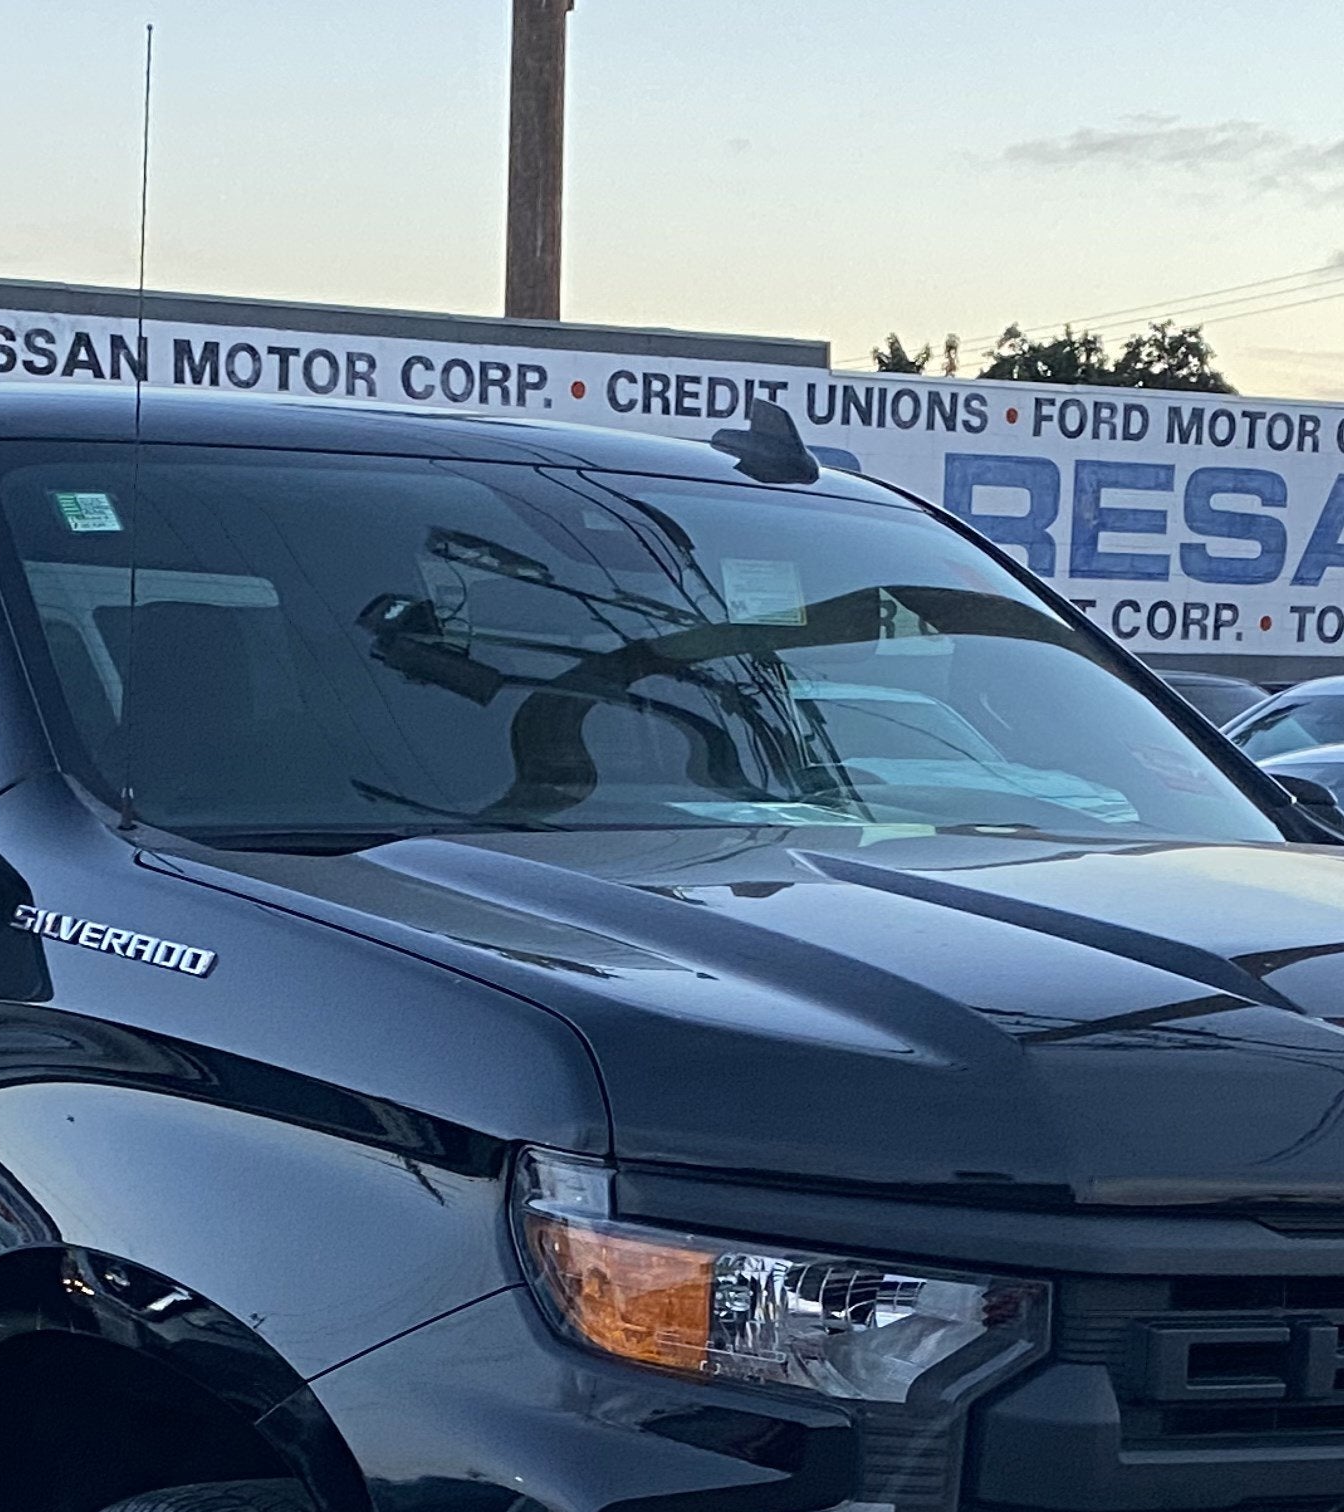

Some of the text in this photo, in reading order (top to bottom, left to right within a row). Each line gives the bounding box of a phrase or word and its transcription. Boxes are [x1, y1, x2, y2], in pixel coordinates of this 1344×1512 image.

[172, 338, 377, 398] MOTOR
[401, 355, 552, 409] CORP.
[607, 370, 788, 420] CREDIT
[807, 382, 988, 434] UNIONS
[1032, 397, 1149, 442] FORD
[1167, 405, 1321, 454] MOTOR
[1112, 600, 1243, 641] CORP.
[10, 904, 216, 977] SILVERADO
